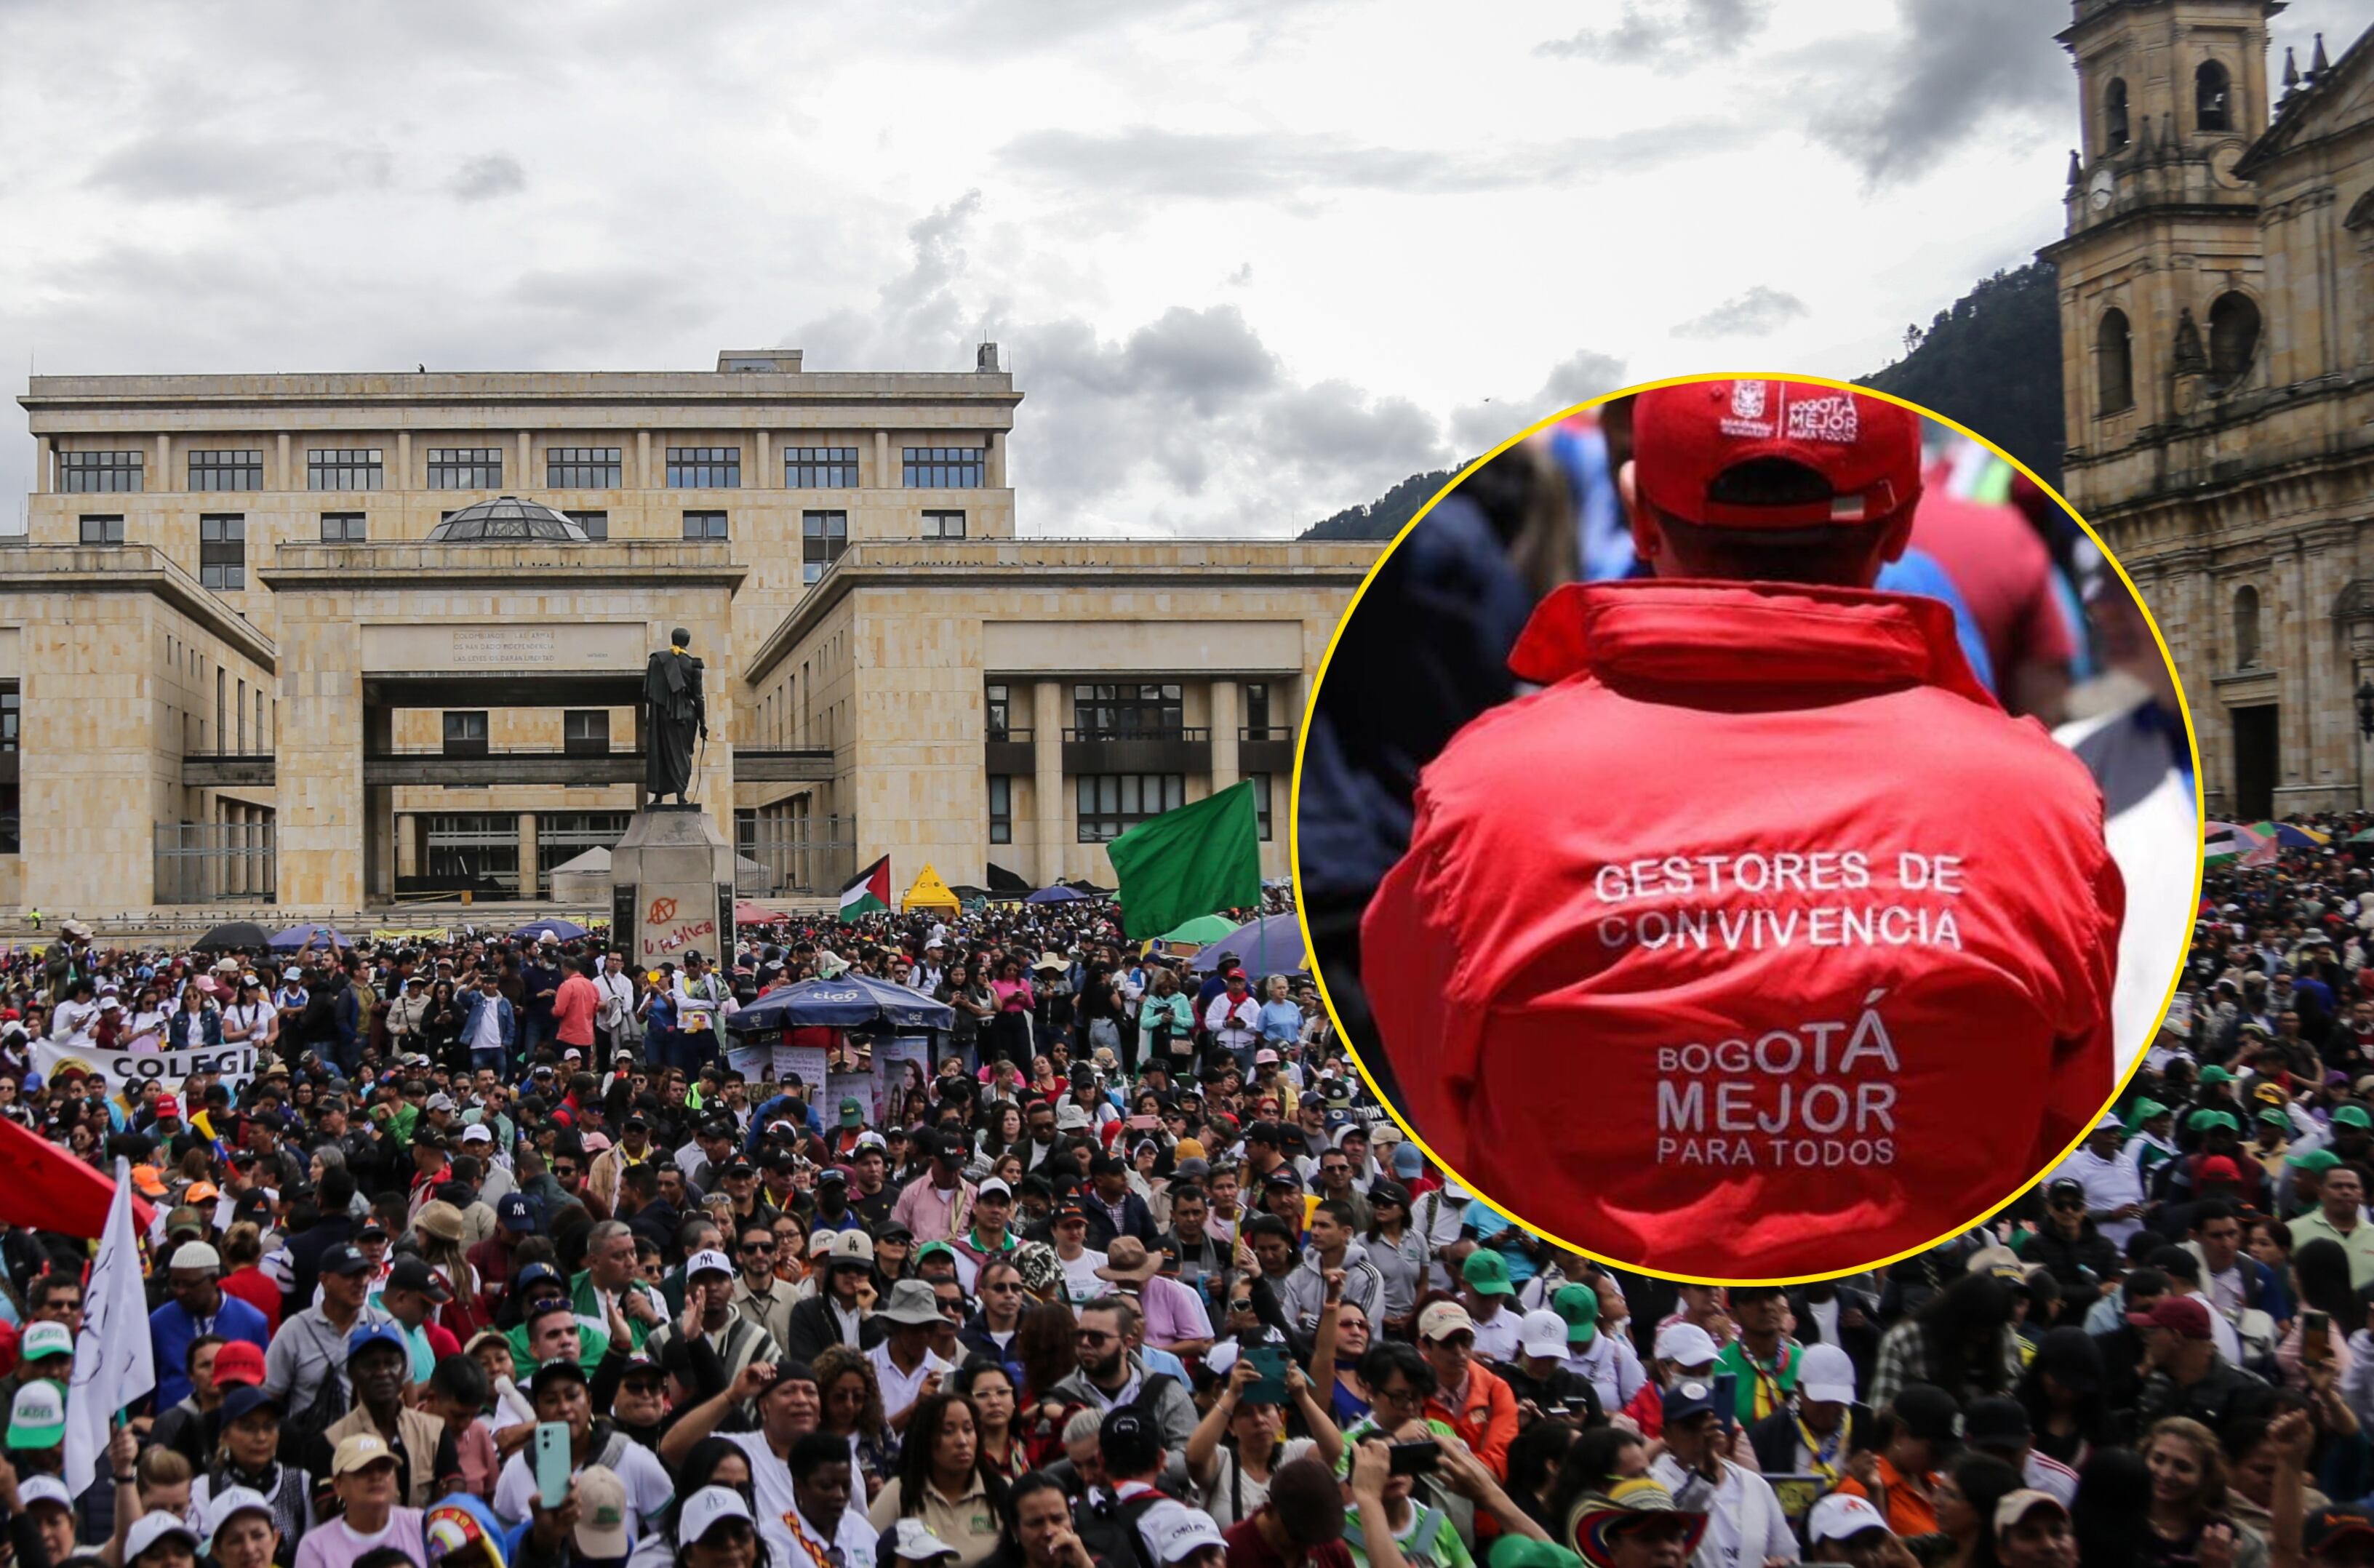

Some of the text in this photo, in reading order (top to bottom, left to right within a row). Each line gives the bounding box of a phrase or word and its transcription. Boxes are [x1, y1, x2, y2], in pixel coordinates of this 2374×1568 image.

[1789, 409, 1858, 431] MEJOR
[1594, 849, 1964, 904] GESTORES DE
[1597, 905, 1963, 951] CONVIVENCIA
[813, 990, 858, 1003] tigo
[1658, 988, 1900, 1074] BOGOTÁ
[1658, 1080, 1897, 1134] MEJOR
[1658, 1137, 1895, 1167] PARA TODOS
